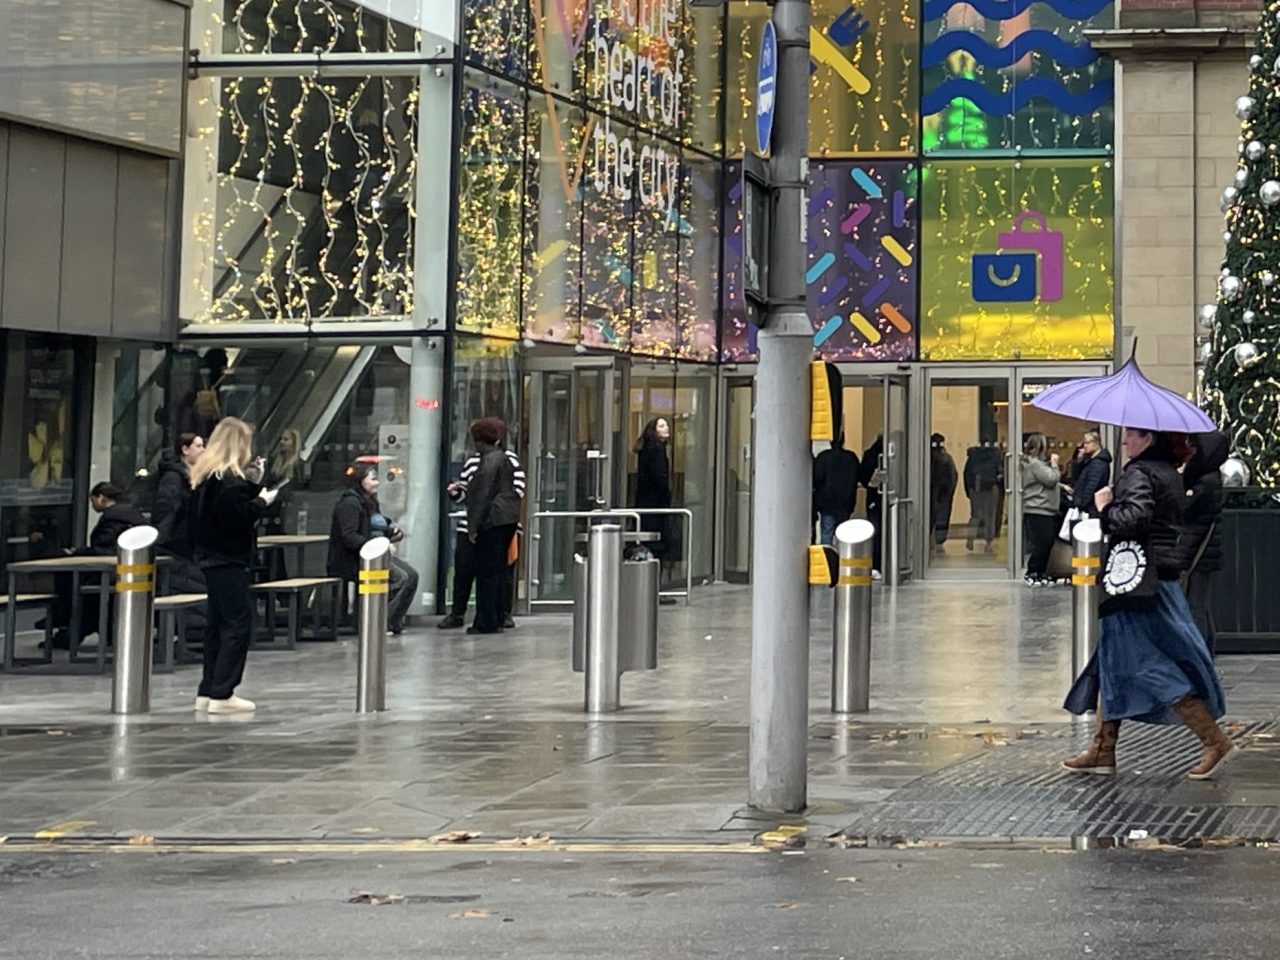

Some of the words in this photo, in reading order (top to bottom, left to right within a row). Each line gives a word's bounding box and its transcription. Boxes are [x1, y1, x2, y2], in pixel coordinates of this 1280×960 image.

[594, 8, 656, 120] heart
[660, 47, 685, 130] of
[594, 106, 634, 201] the
[639, 126, 678, 232] city
